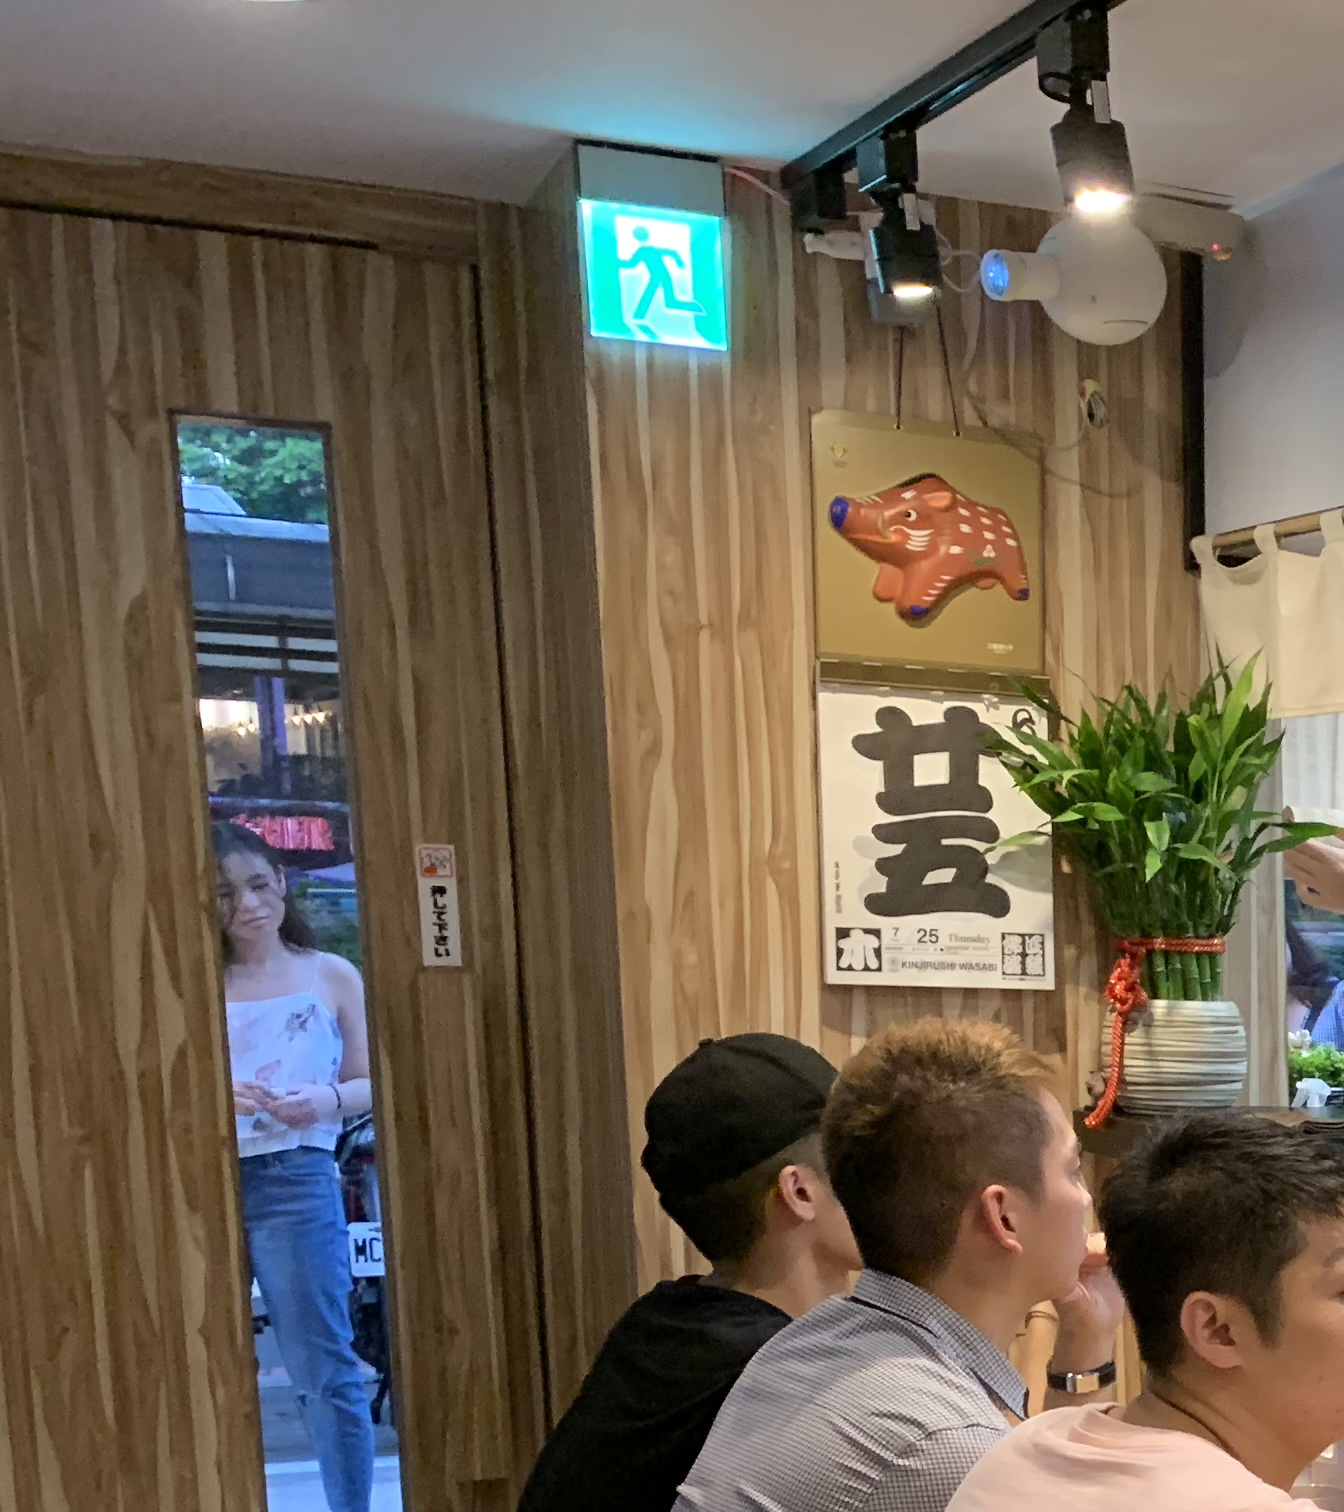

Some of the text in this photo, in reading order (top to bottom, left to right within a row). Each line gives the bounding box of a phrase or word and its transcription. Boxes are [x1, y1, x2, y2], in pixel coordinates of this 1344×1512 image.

[892, 927, 991, 945] 7 25 Thursday
[836, 928, 881, 970] 木
[901, 960, 998, 972] KINJIRUSHI WASABI
